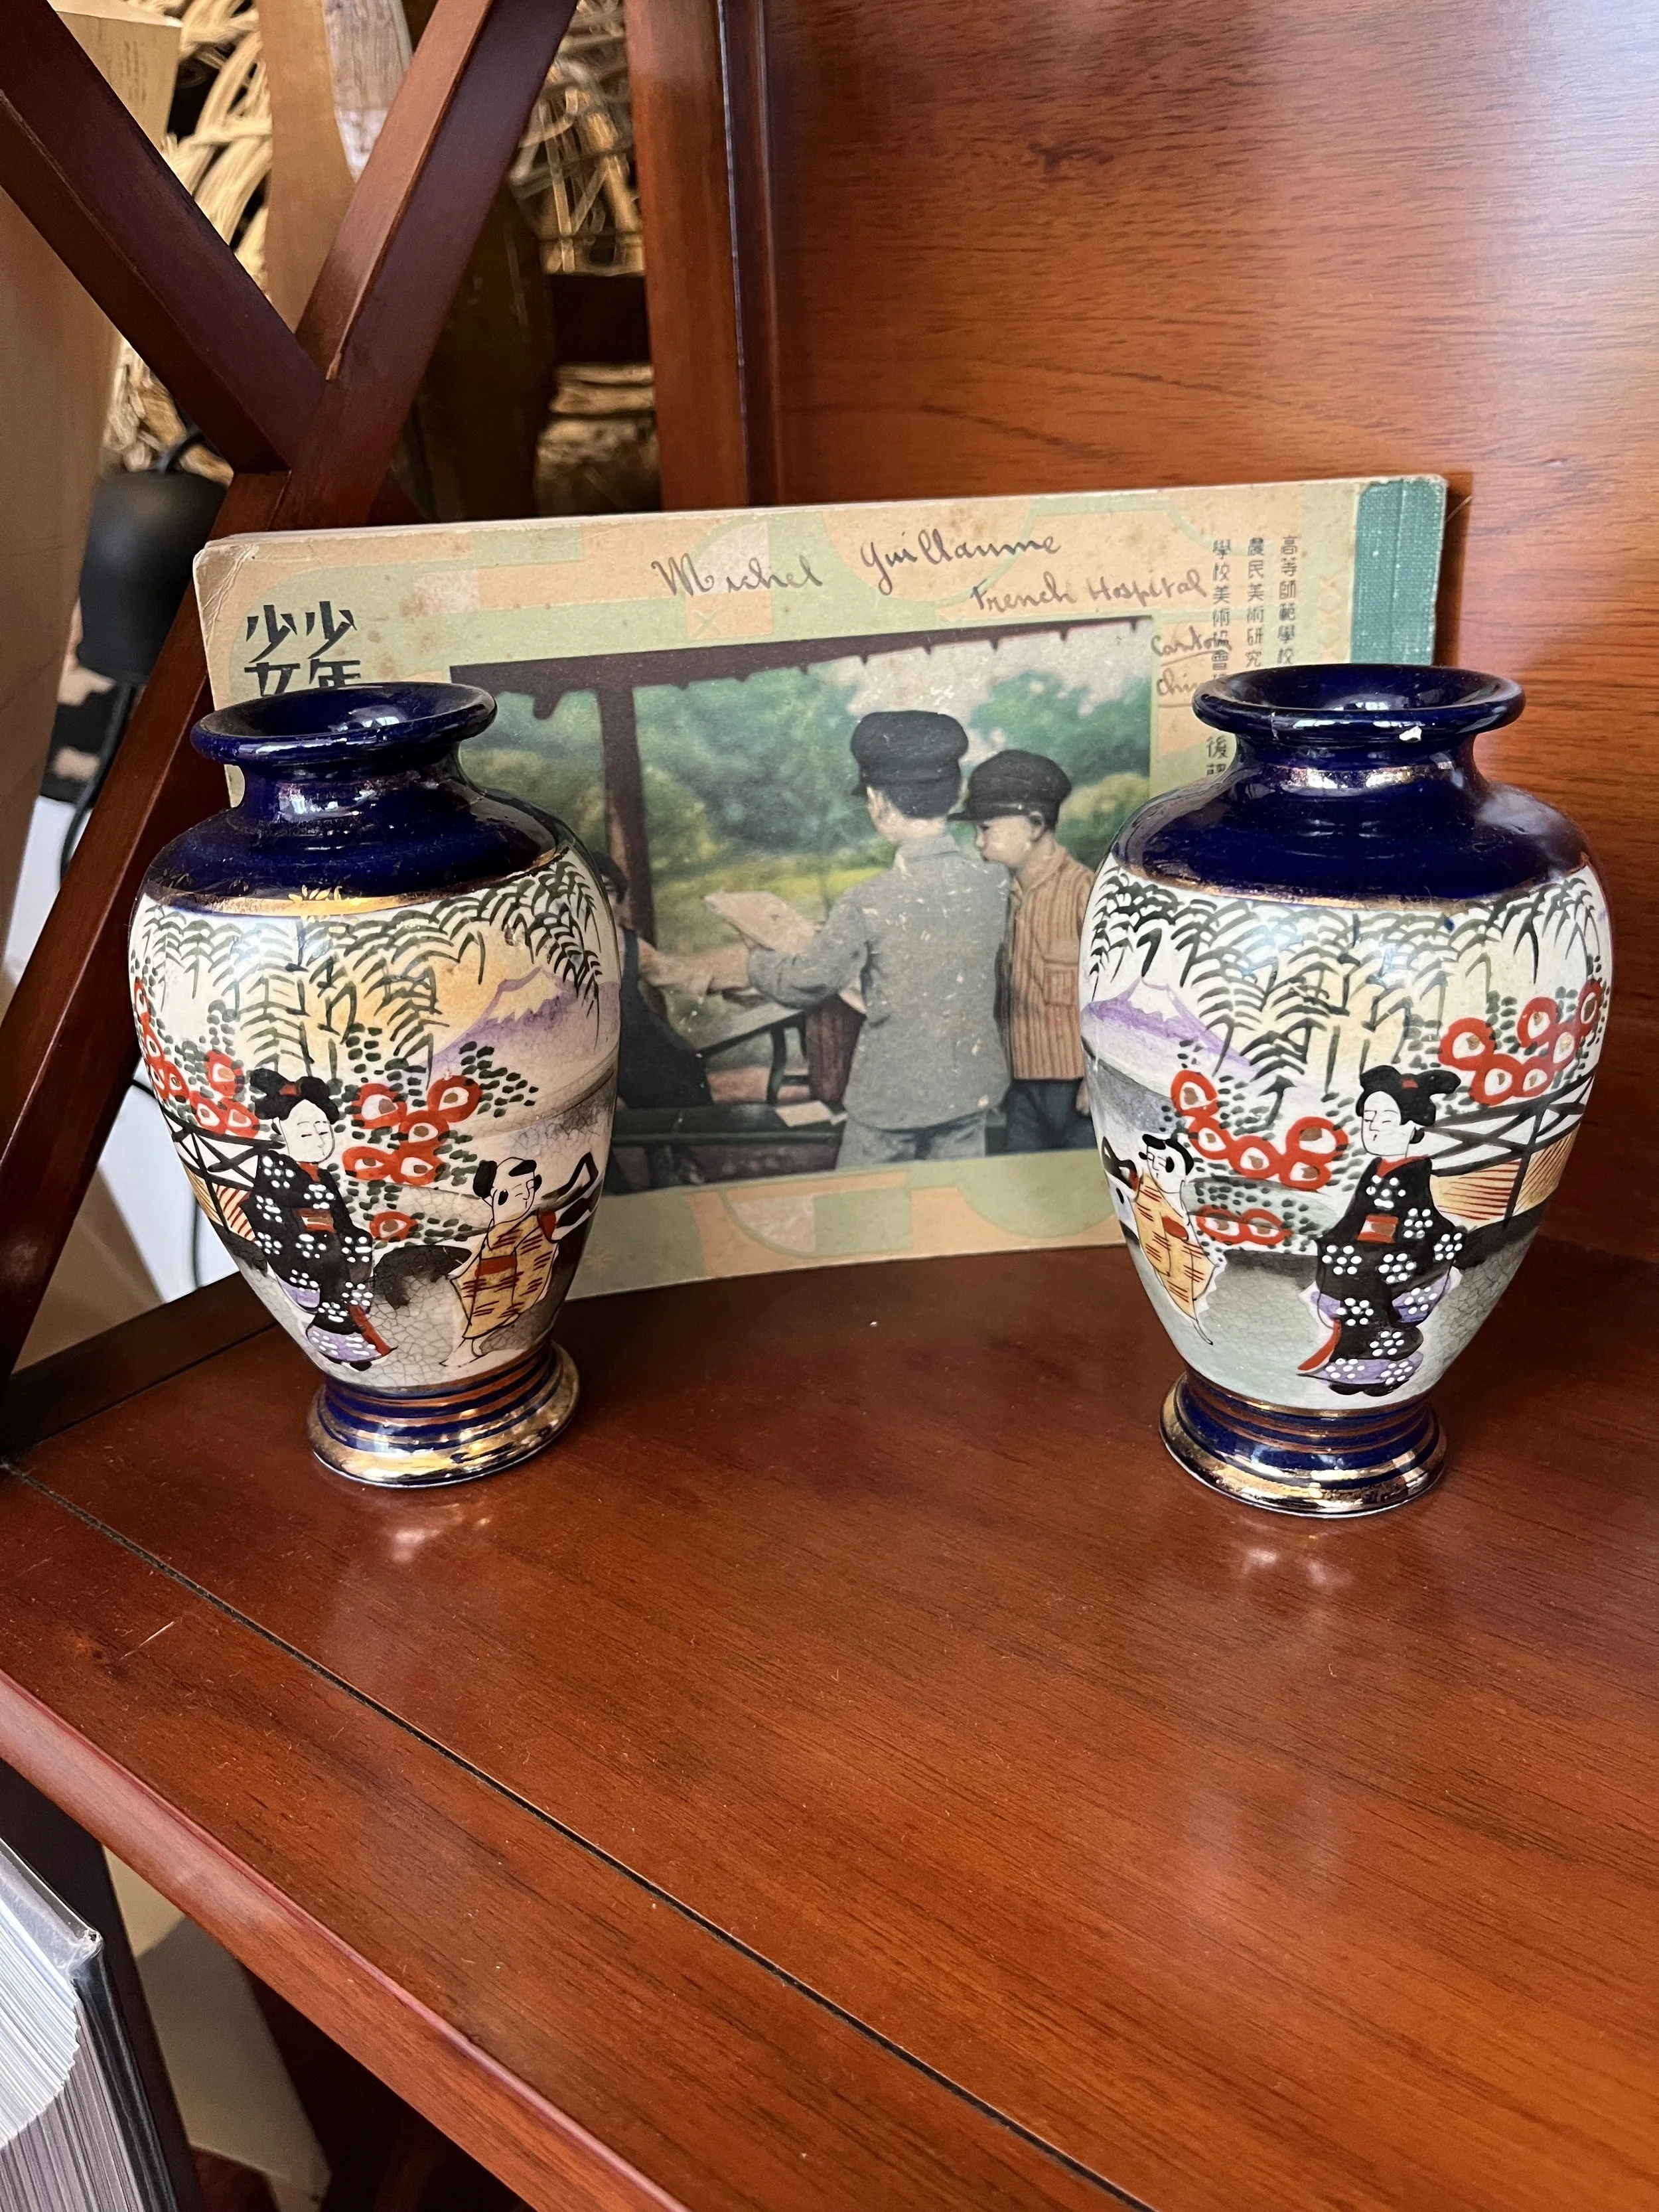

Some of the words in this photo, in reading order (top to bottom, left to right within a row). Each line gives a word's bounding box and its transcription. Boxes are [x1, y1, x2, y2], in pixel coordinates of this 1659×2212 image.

[650, 552, 824, 596] Michel
[970, 569, 1076, 613] French
[1087, 569, 1206, 607] Hospital
[1211, 539, 1232, 680] 學校美術協會
[1156, 668, 1197, 696] Chin
